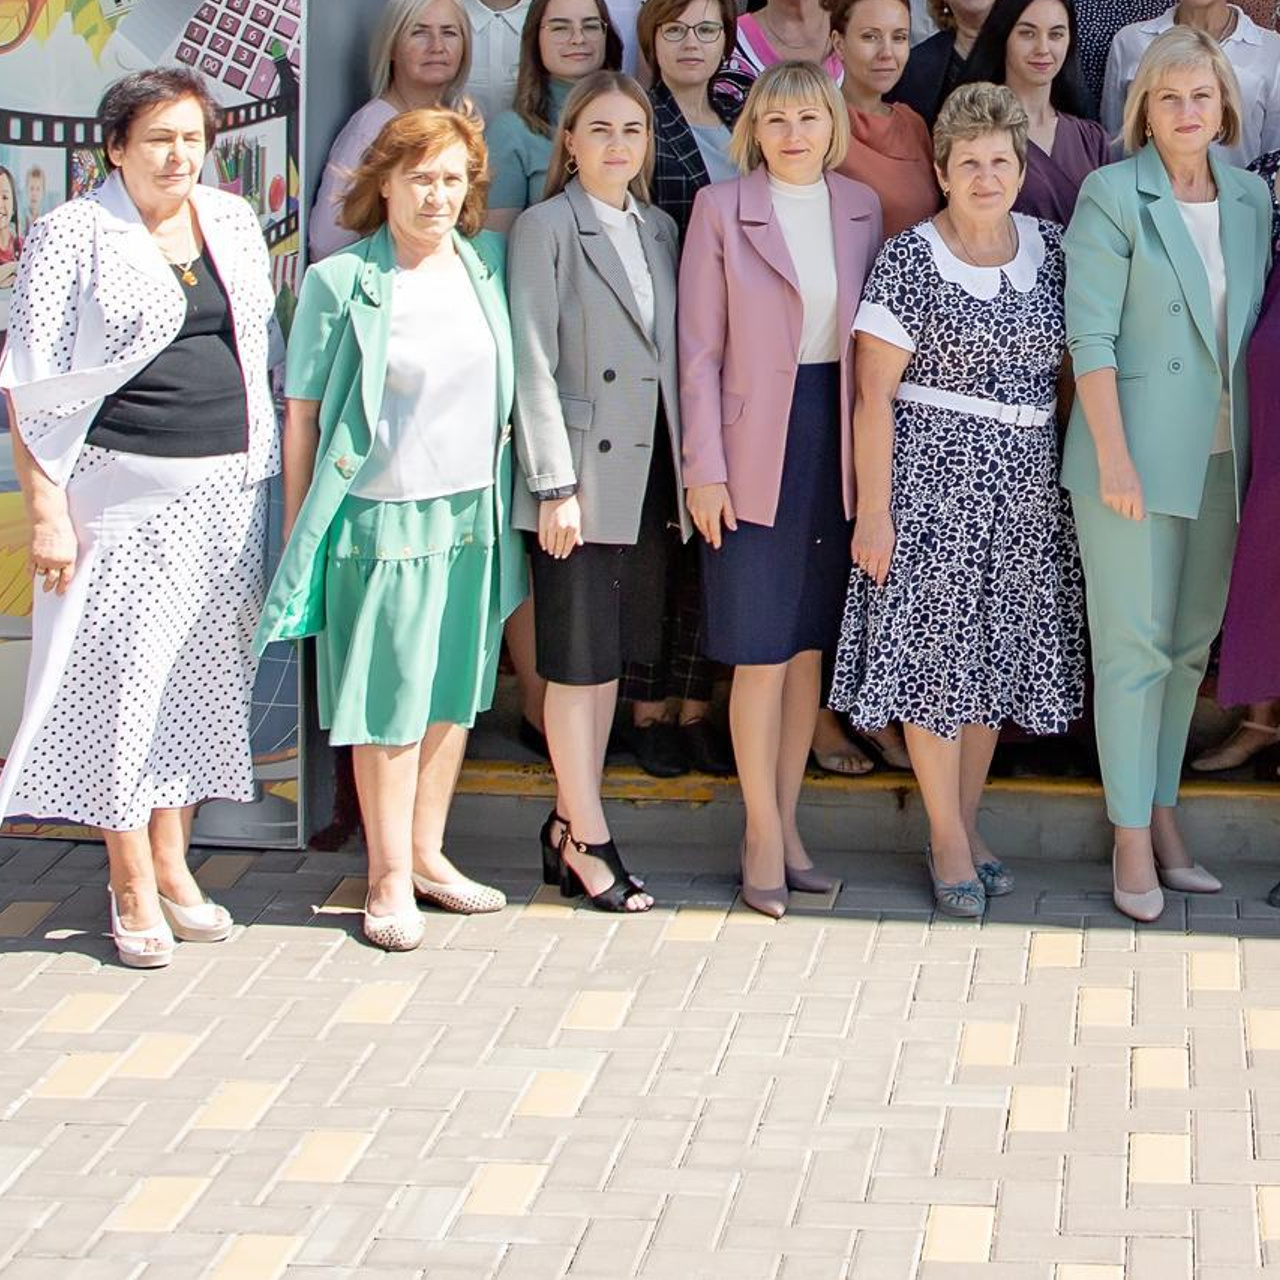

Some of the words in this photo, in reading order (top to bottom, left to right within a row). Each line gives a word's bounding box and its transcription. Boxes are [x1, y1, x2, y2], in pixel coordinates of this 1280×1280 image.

[258, 9, 267, 20] 9
[224, 18, 233, 29] 5
[249, 30, 257, 41] 6
[215, 38, 225, 50] 2
[240, 50, 249, 61] 3
